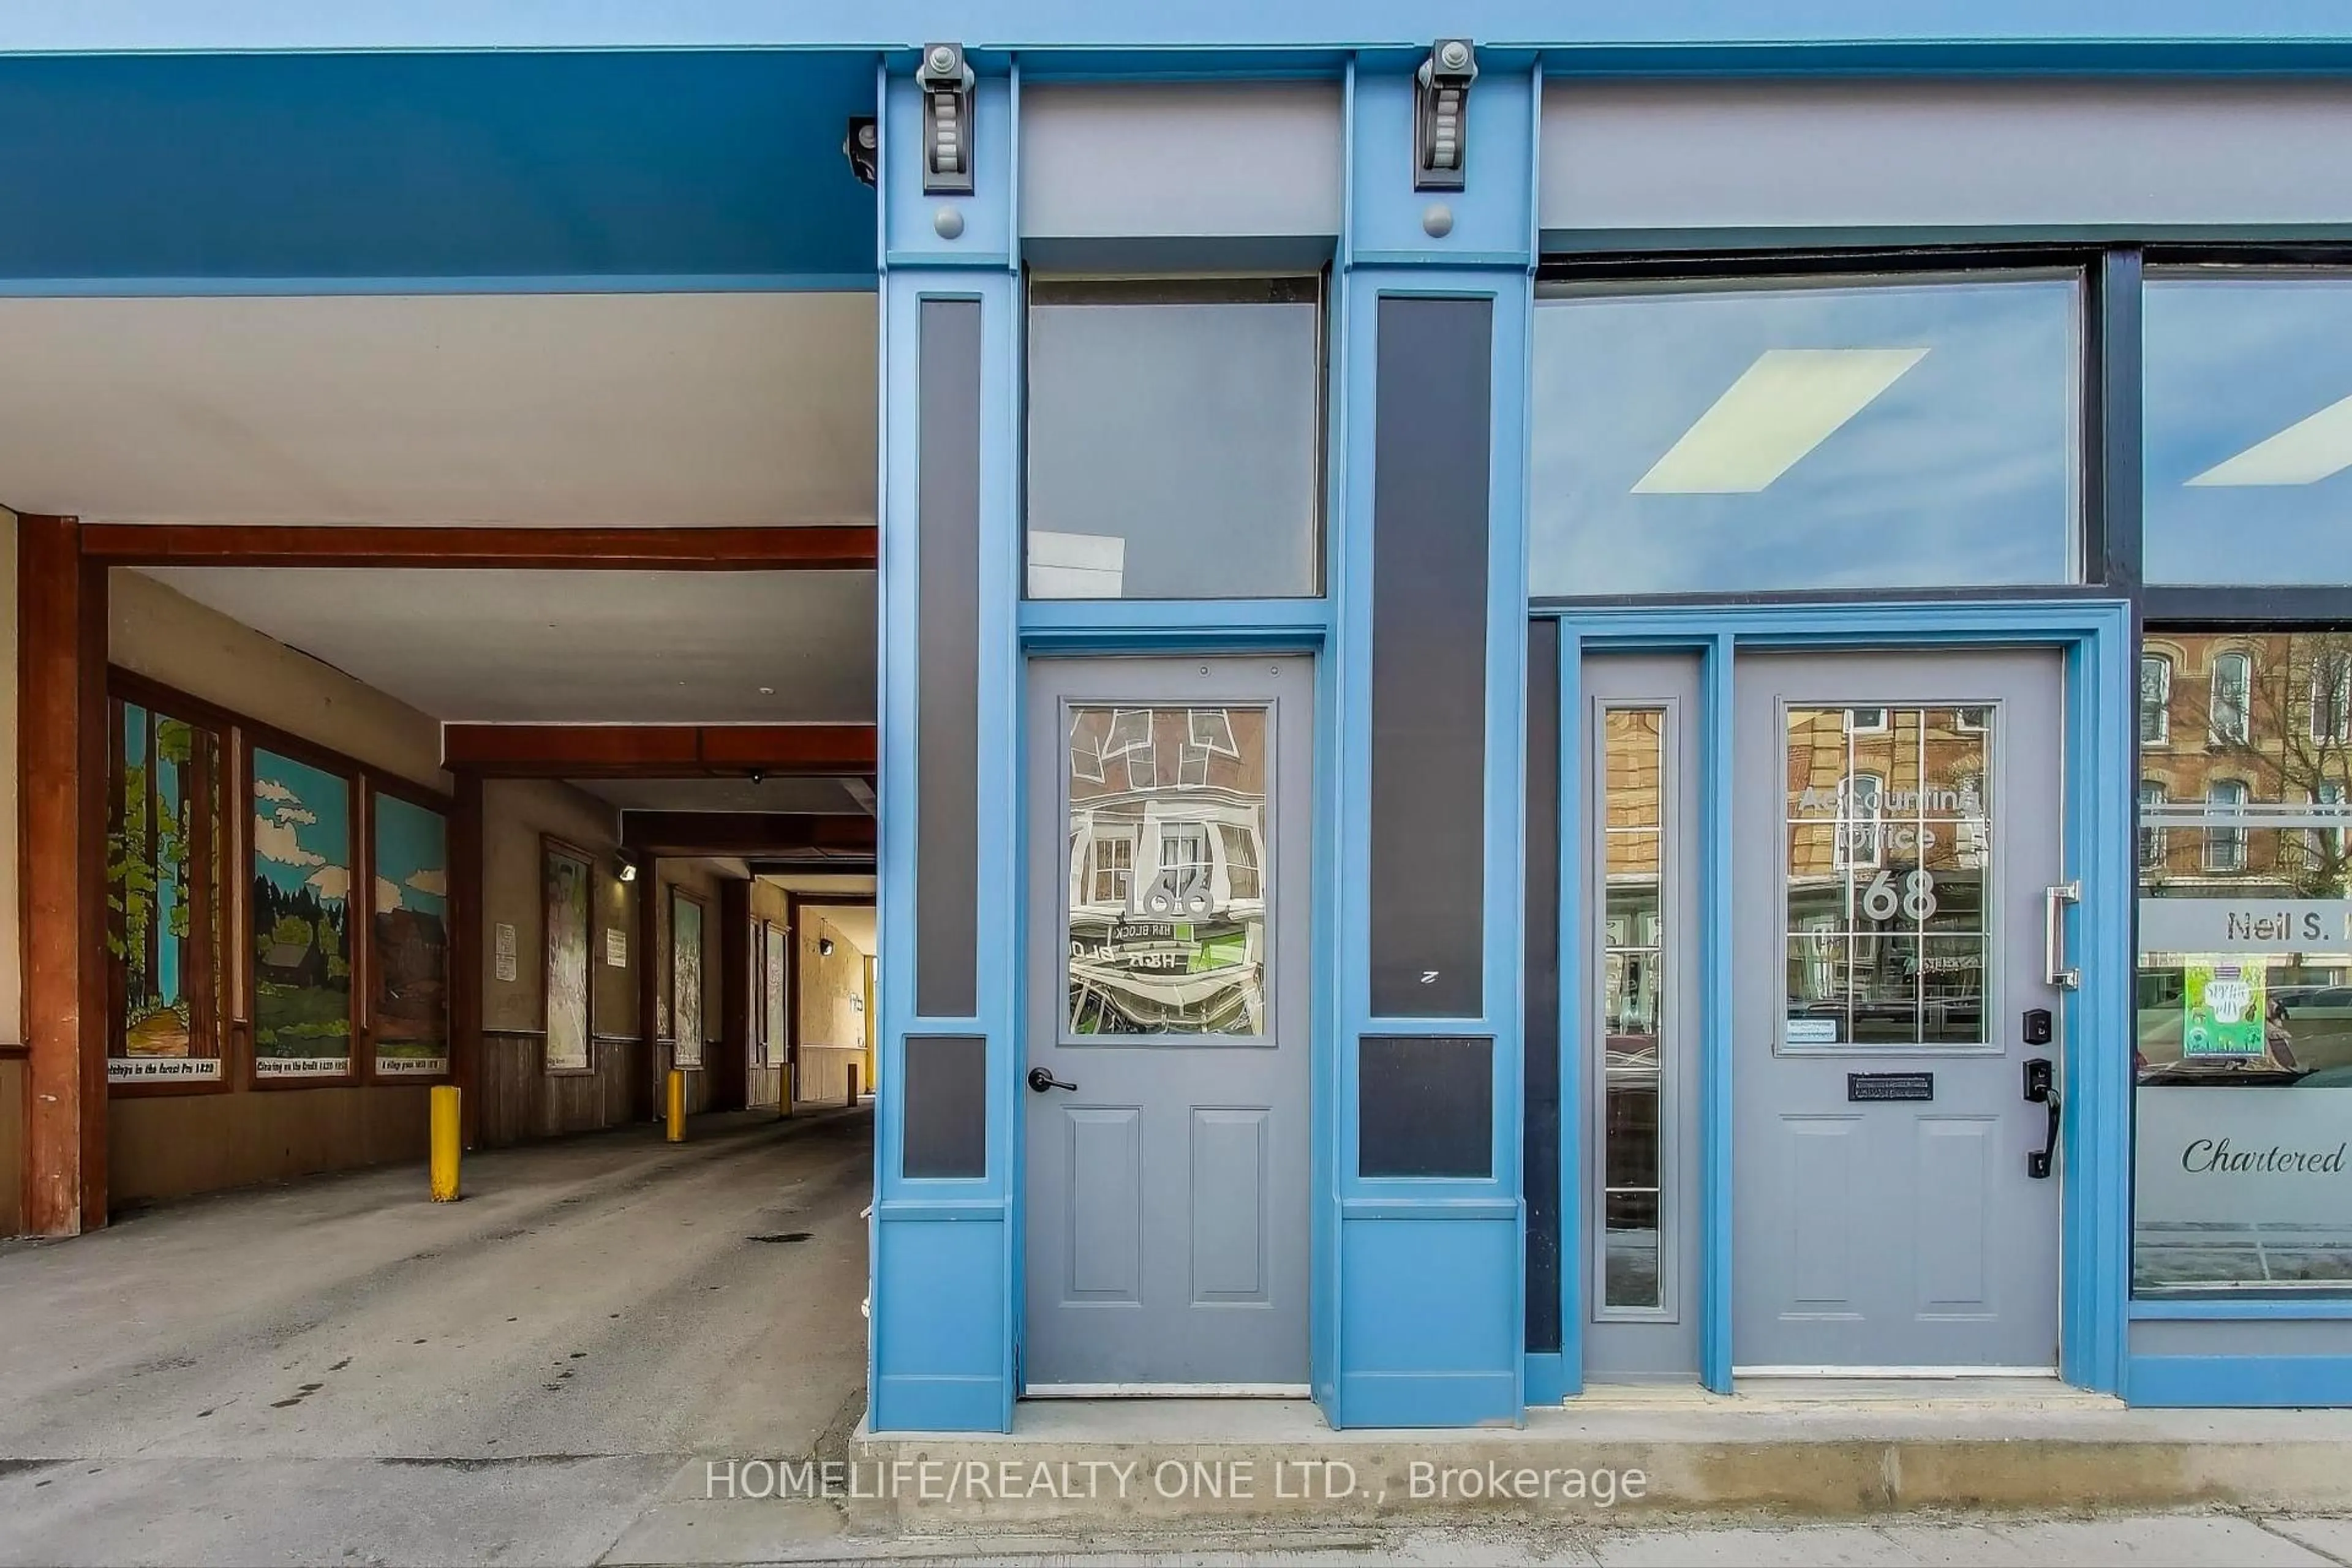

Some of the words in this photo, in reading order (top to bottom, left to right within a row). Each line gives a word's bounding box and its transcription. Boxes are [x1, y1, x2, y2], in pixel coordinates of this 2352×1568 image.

[1120, 870, 1213, 919] 166
[2228, 912, 2291, 940] Neil
[2303, 912, 2329, 940] S.
[2182, 1137, 2347, 1172] Chartered
